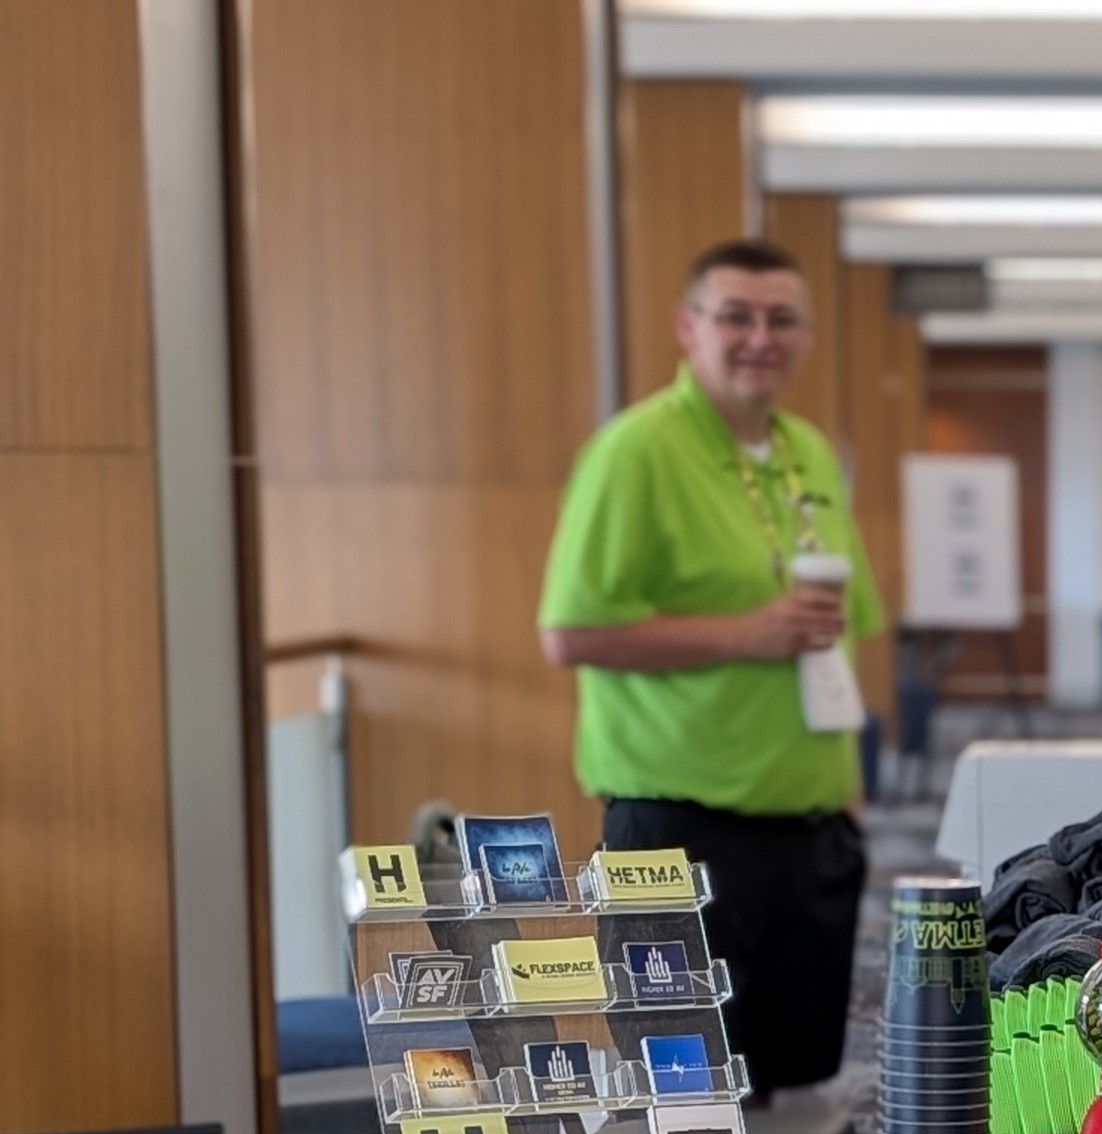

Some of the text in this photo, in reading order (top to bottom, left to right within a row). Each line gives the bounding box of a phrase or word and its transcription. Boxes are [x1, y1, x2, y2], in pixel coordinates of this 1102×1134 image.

[368, 855, 407, 893] H
[607, 865, 684, 885] HETMA
[911, 919, 986, 950] ETMA
[418, 969, 455, 984] AV
[529, 961, 595, 975] FLEXSPACE
[416, 985, 447, 1003] SF
